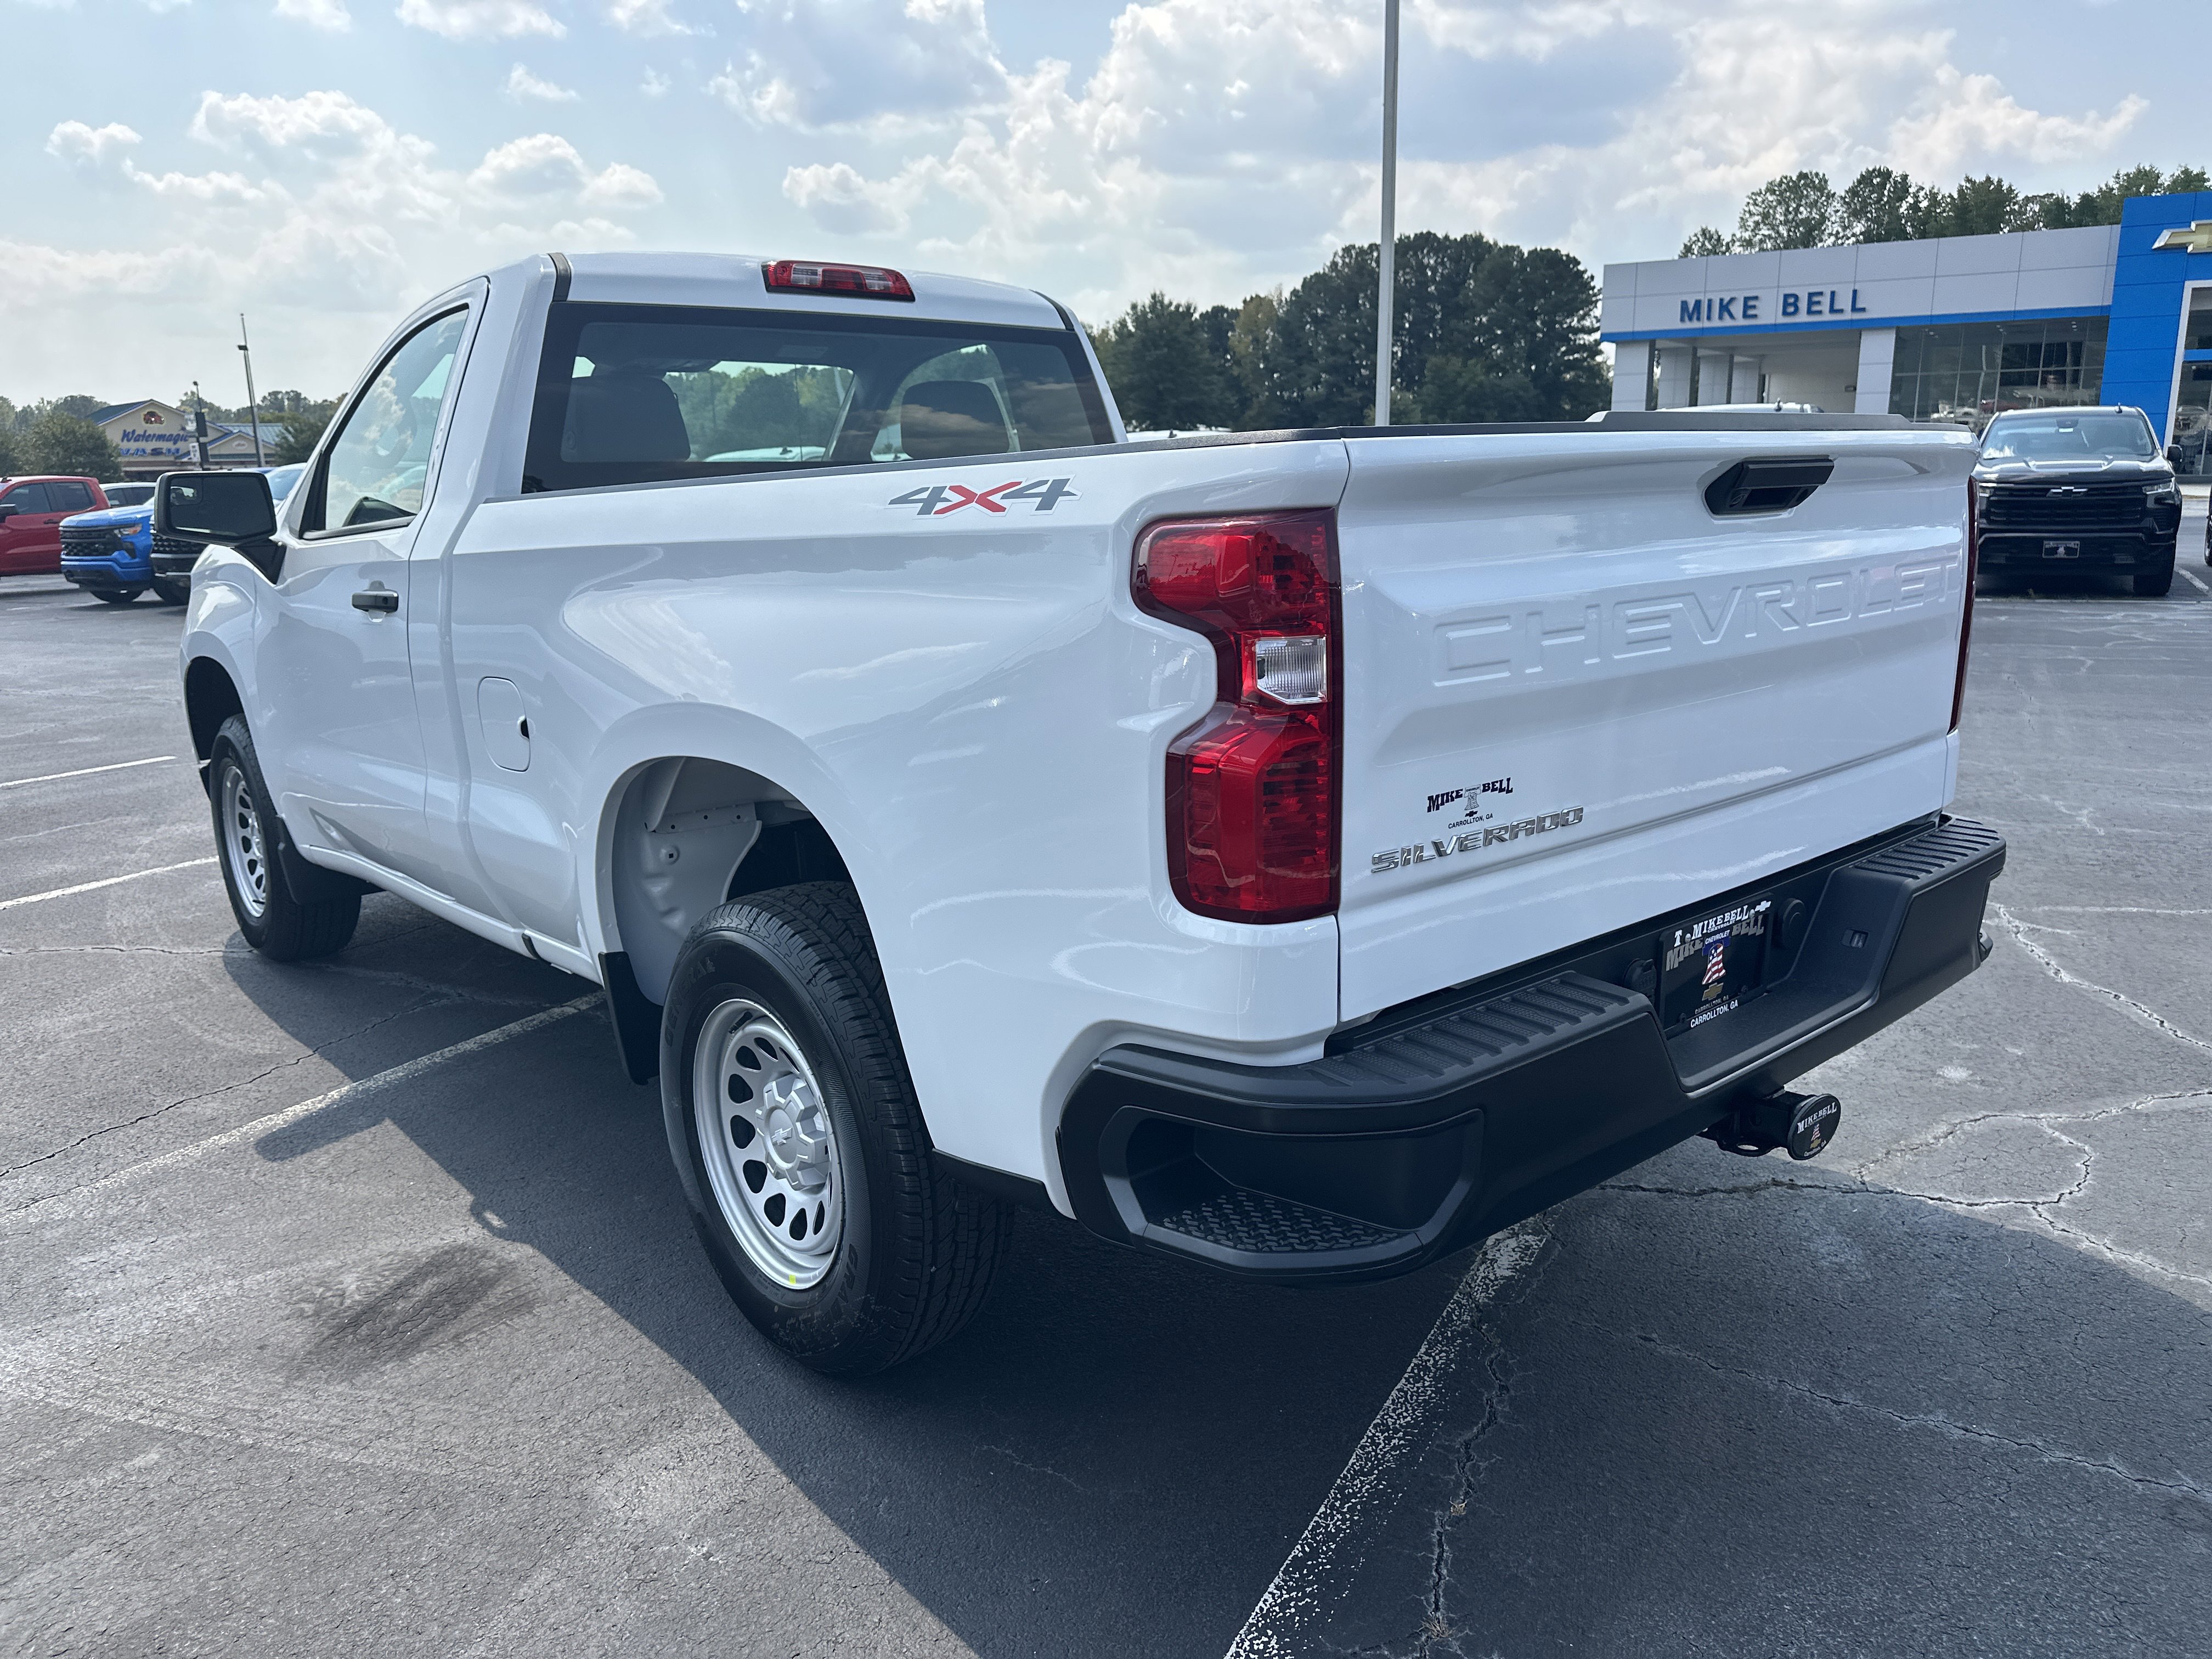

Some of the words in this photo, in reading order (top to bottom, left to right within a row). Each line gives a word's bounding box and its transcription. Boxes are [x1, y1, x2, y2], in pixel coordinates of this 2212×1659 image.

[1680, 296, 1759, 323] MIKE
[1781, 289, 1866, 317] BELL
[121, 429, 189, 445] Watermagic
[1433, 552, 1960, 686] CHEVROLET
[1427, 789, 1463, 812] MIKE
[1482, 777, 1513, 794] BELL
[1448, 815, 1485, 828] CARROLLTON,
[1371, 805, 1584, 873] SILVERADO
[1705, 930, 1730, 945] CHEVROLET
[1707, 920, 1736, 933] CHEVROLET
[1666, 938, 1703, 971] MIKE
[1732, 915, 1764, 936] BELL
[1690, 1004, 1729, 1028] CARROLLTON,
[1730, 1000, 1738, 1009] GA
